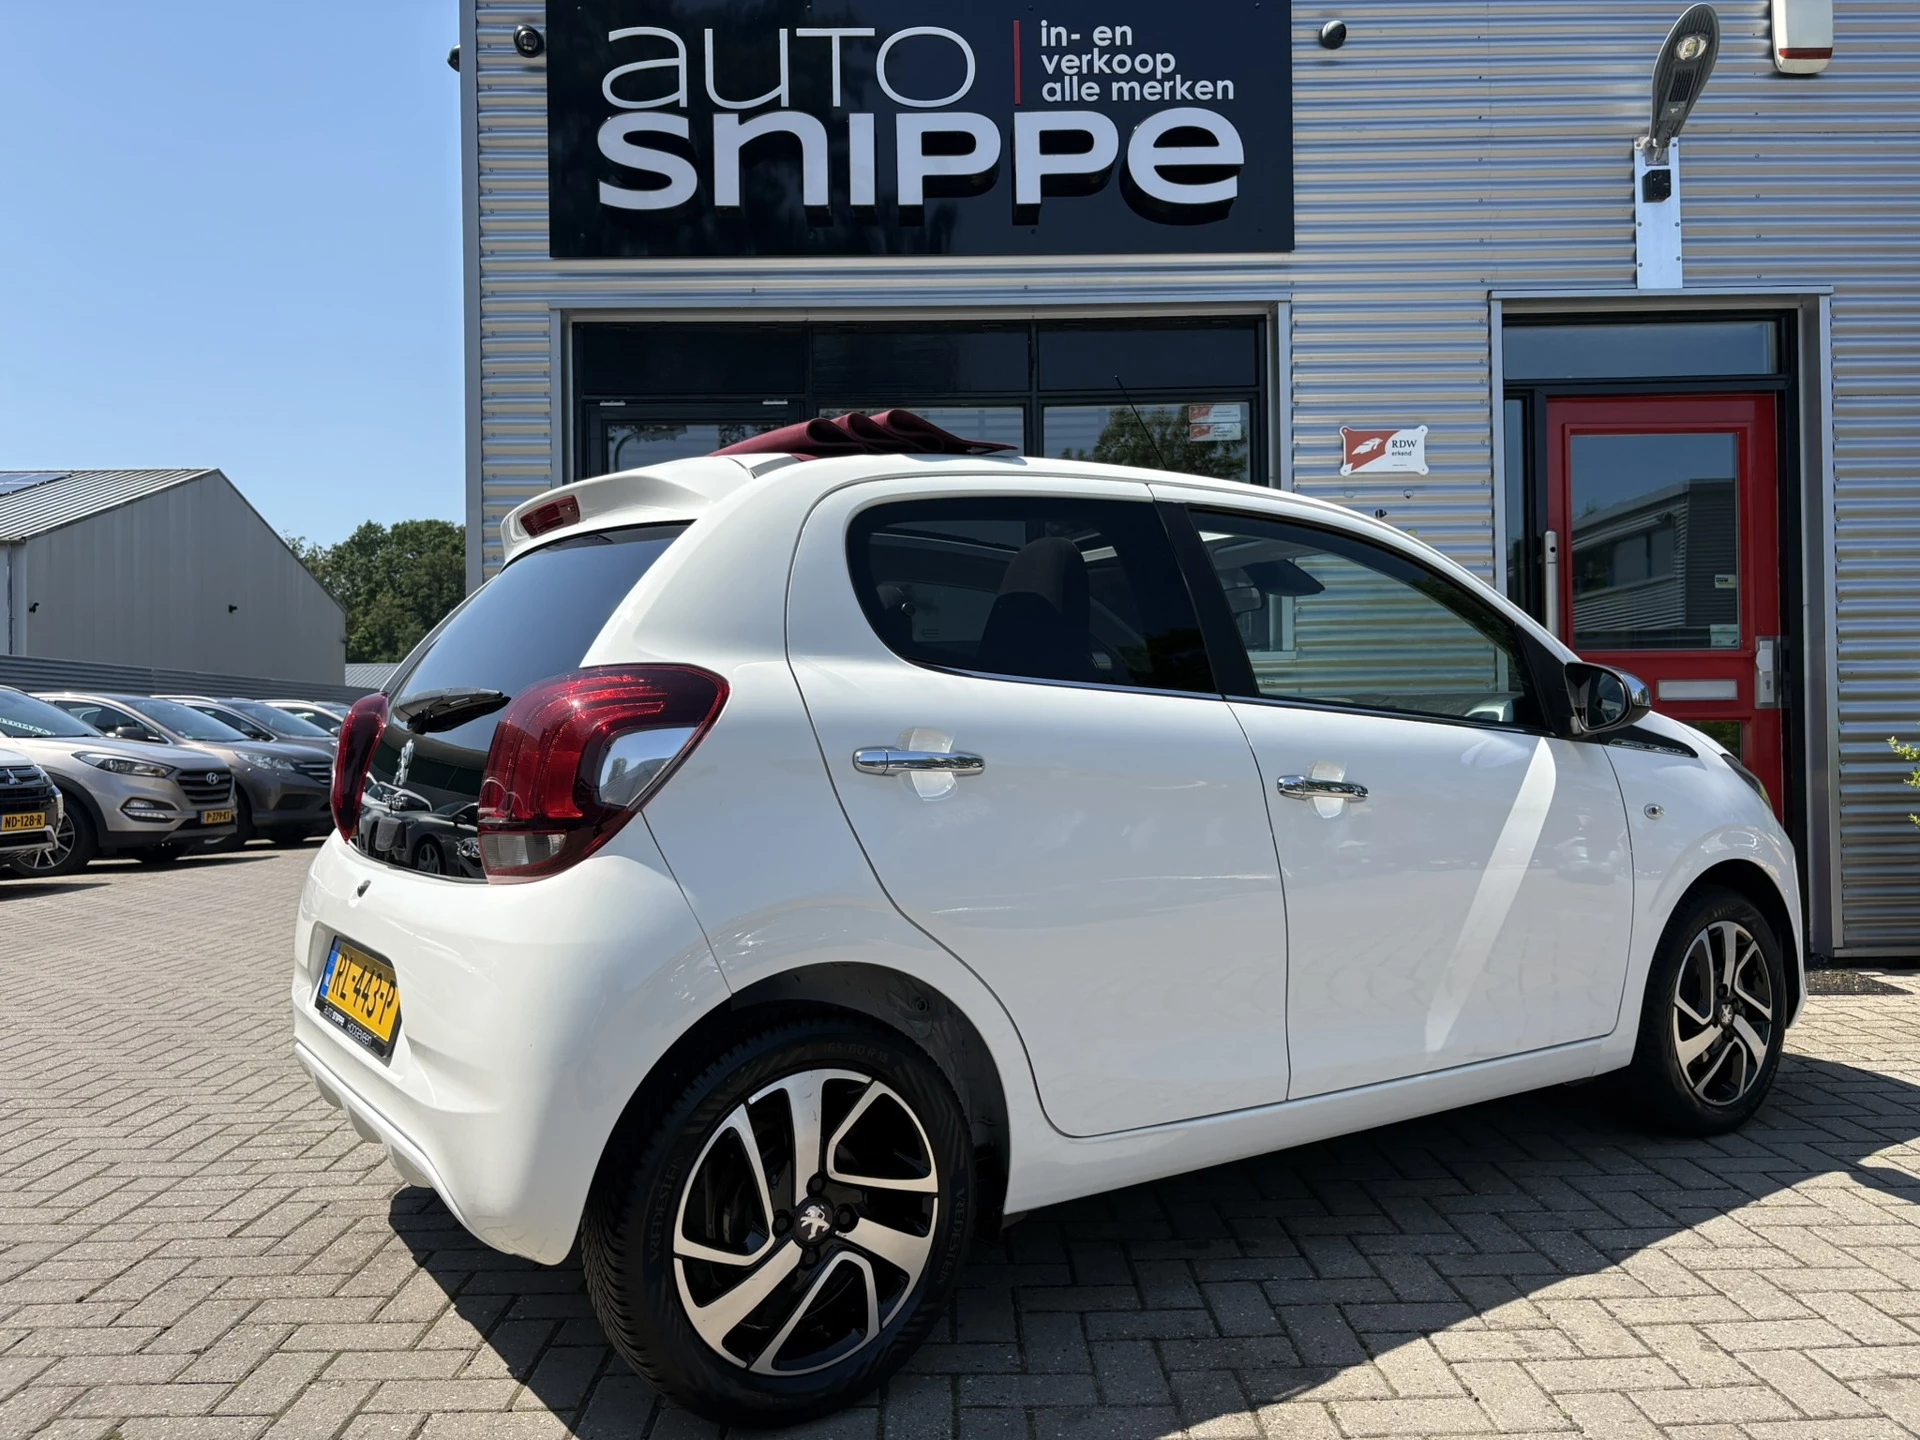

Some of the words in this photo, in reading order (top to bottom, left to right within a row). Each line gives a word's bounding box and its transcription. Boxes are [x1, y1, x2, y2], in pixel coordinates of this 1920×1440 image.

[1040, 19, 1081, 47] in-
[1093, 25, 1133, 47] en
[1040, 47, 1176, 80] verkoop
[1042, 75, 1101, 102] alle
[1111, 74, 1234, 102] merken
[1391, 440, 1418, 449] RDW
[4, 814, 42, 829] ND-128-R
[331, 952, 398, 1026] RL-443-P
